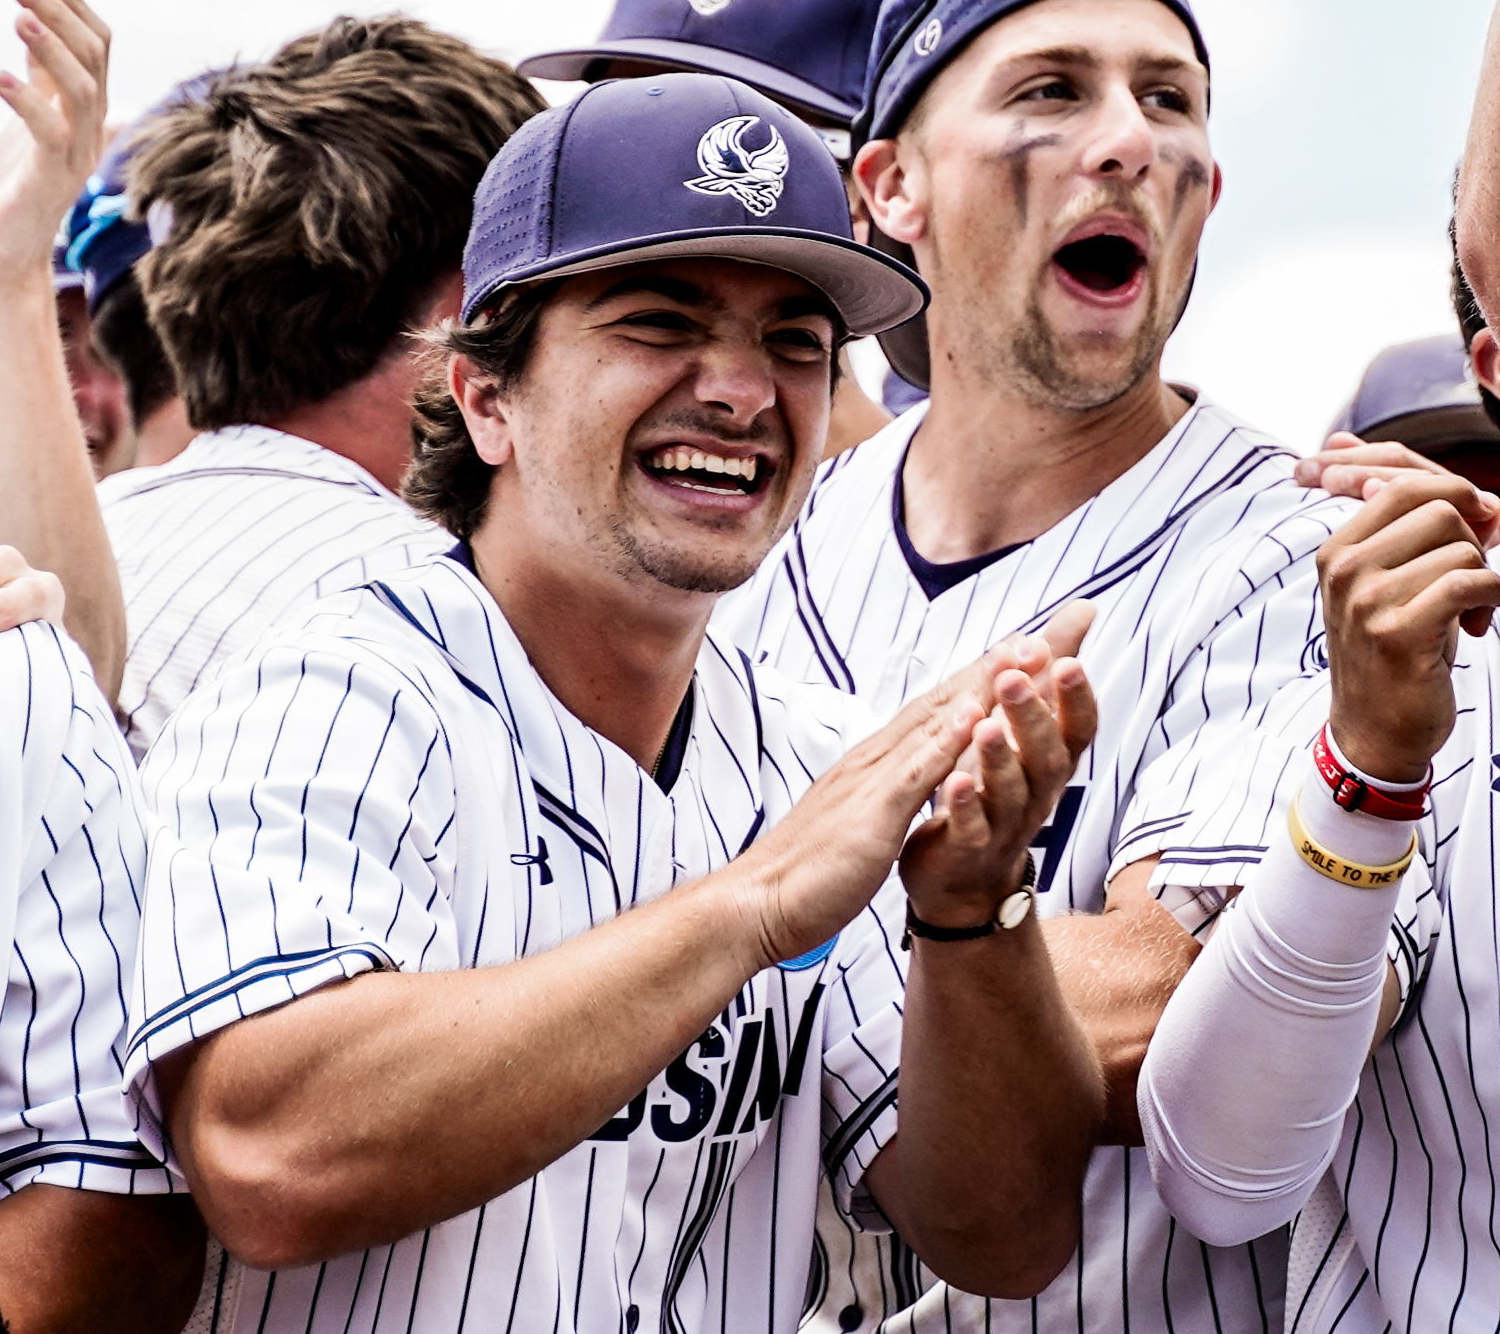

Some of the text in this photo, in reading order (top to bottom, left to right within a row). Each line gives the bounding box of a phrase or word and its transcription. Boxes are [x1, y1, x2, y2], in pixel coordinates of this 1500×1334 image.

[1301, 840, 1337, 873] SMILE
[1342, 865, 1363, 881] TO
[1368, 870, 1395, 884] THE
